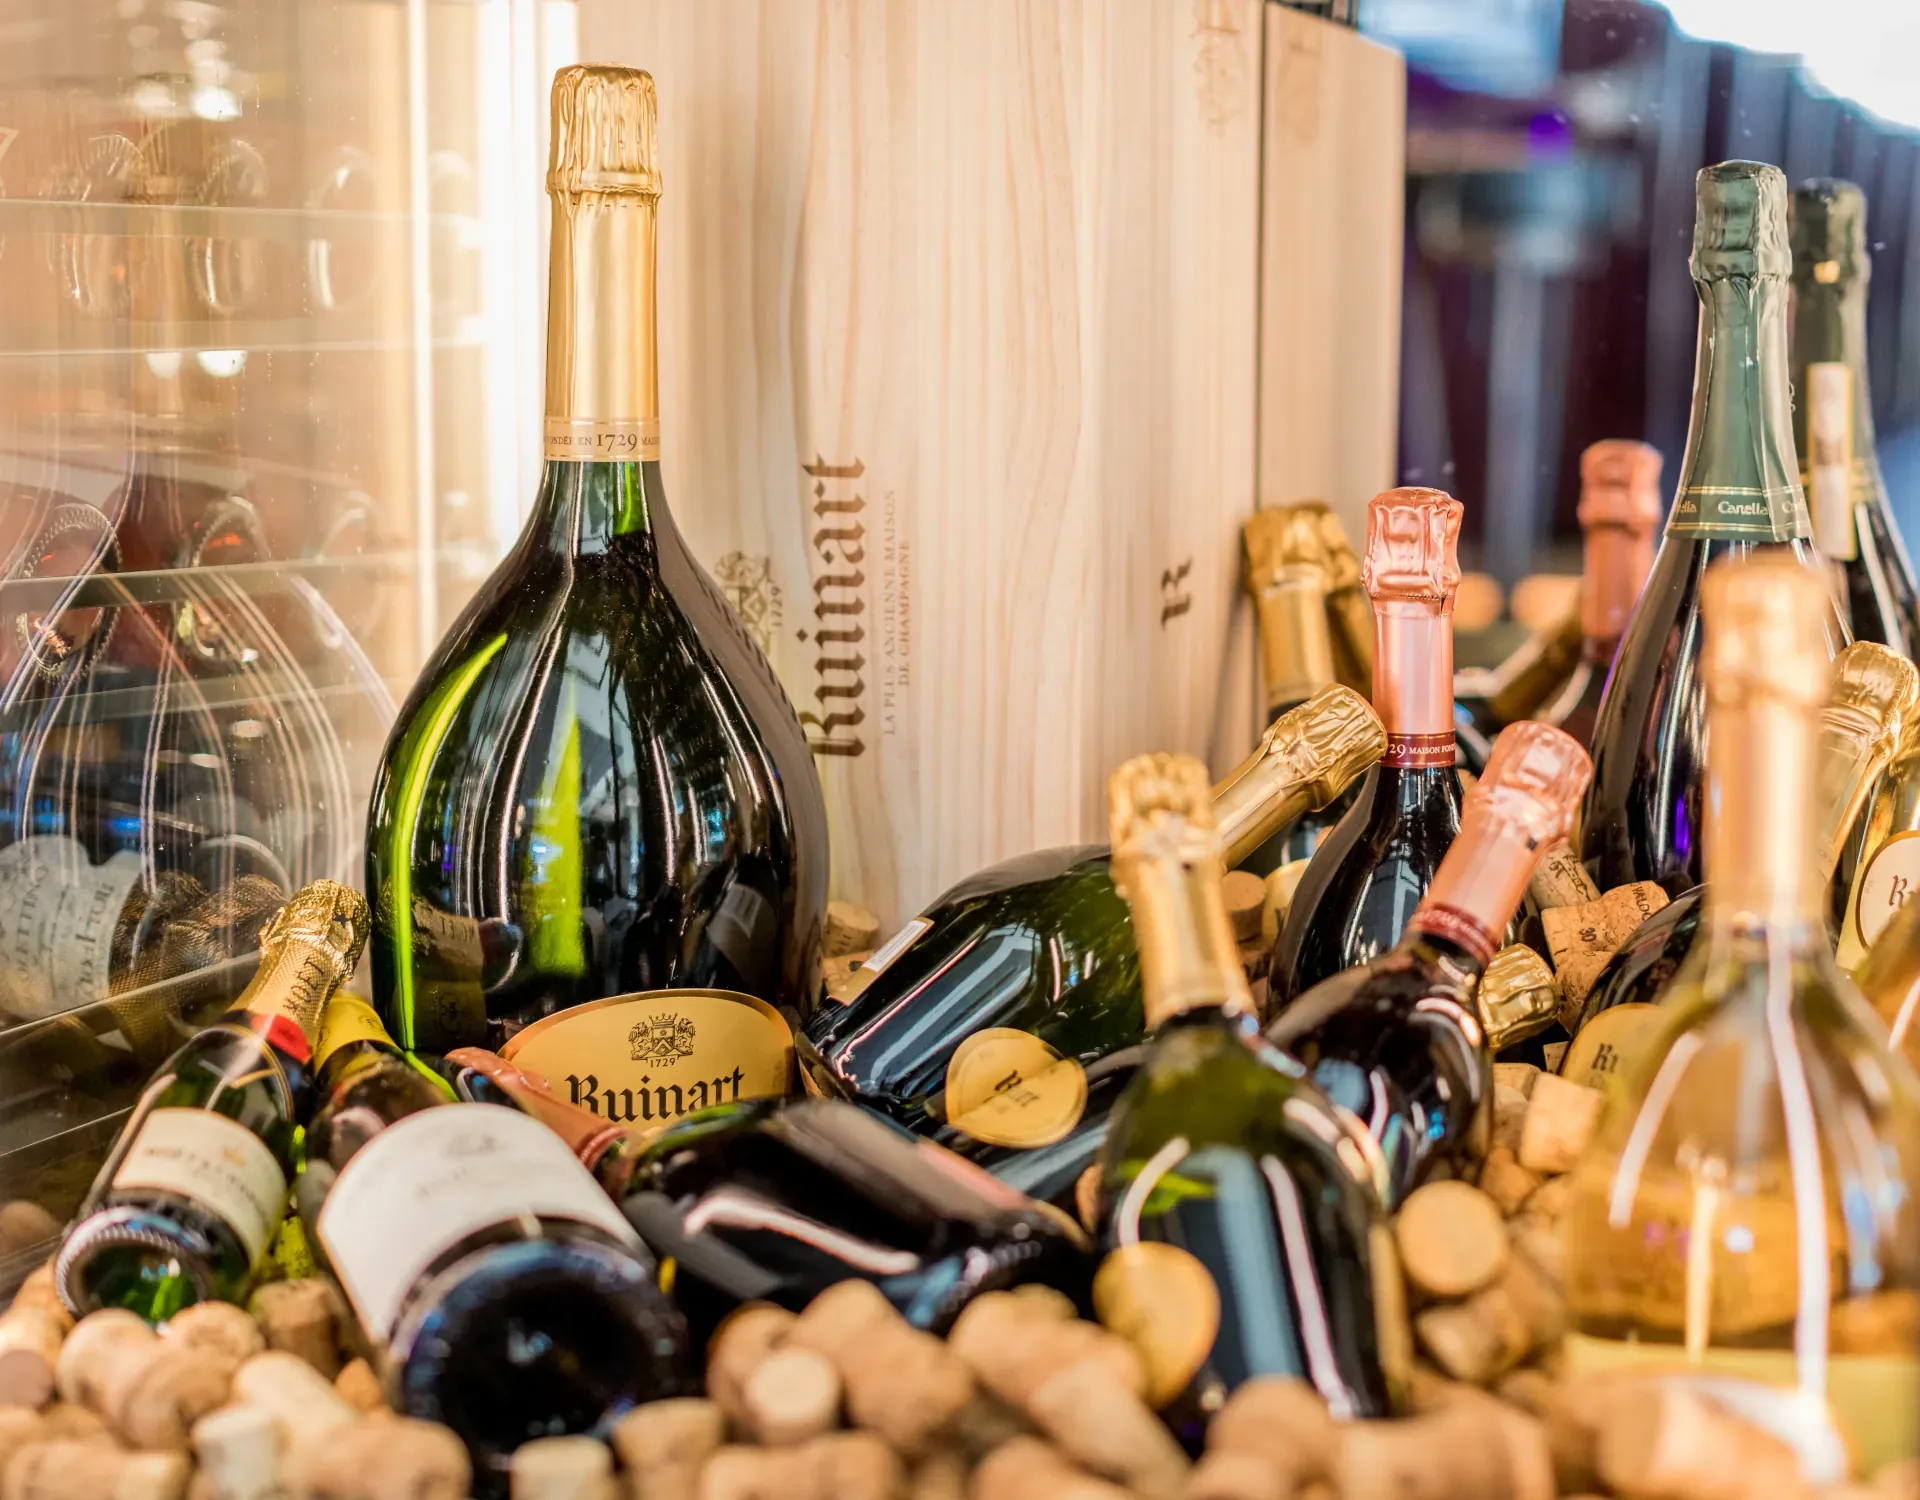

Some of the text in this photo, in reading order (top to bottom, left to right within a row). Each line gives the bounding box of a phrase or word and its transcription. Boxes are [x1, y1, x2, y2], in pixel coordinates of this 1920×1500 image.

[578, 437, 593, 446] EN
[596, 433, 638, 452] 1729
[1717, 500, 1769, 516] Canella
[771, 585, 783, 628] 1729
[796, 453, 866, 757] Ruinart
[884, 490, 896, 737] LA PLUS ANCIENNE MAISON
[898, 541, 910, 687] DE CHAMPAGNE
[1387, 743, 1407, 759] 29
[1408, 745, 1440, 754] MAISON
[650, 1058, 676, 1068] 1729
[564, 1065, 746, 1123] Ruinart
